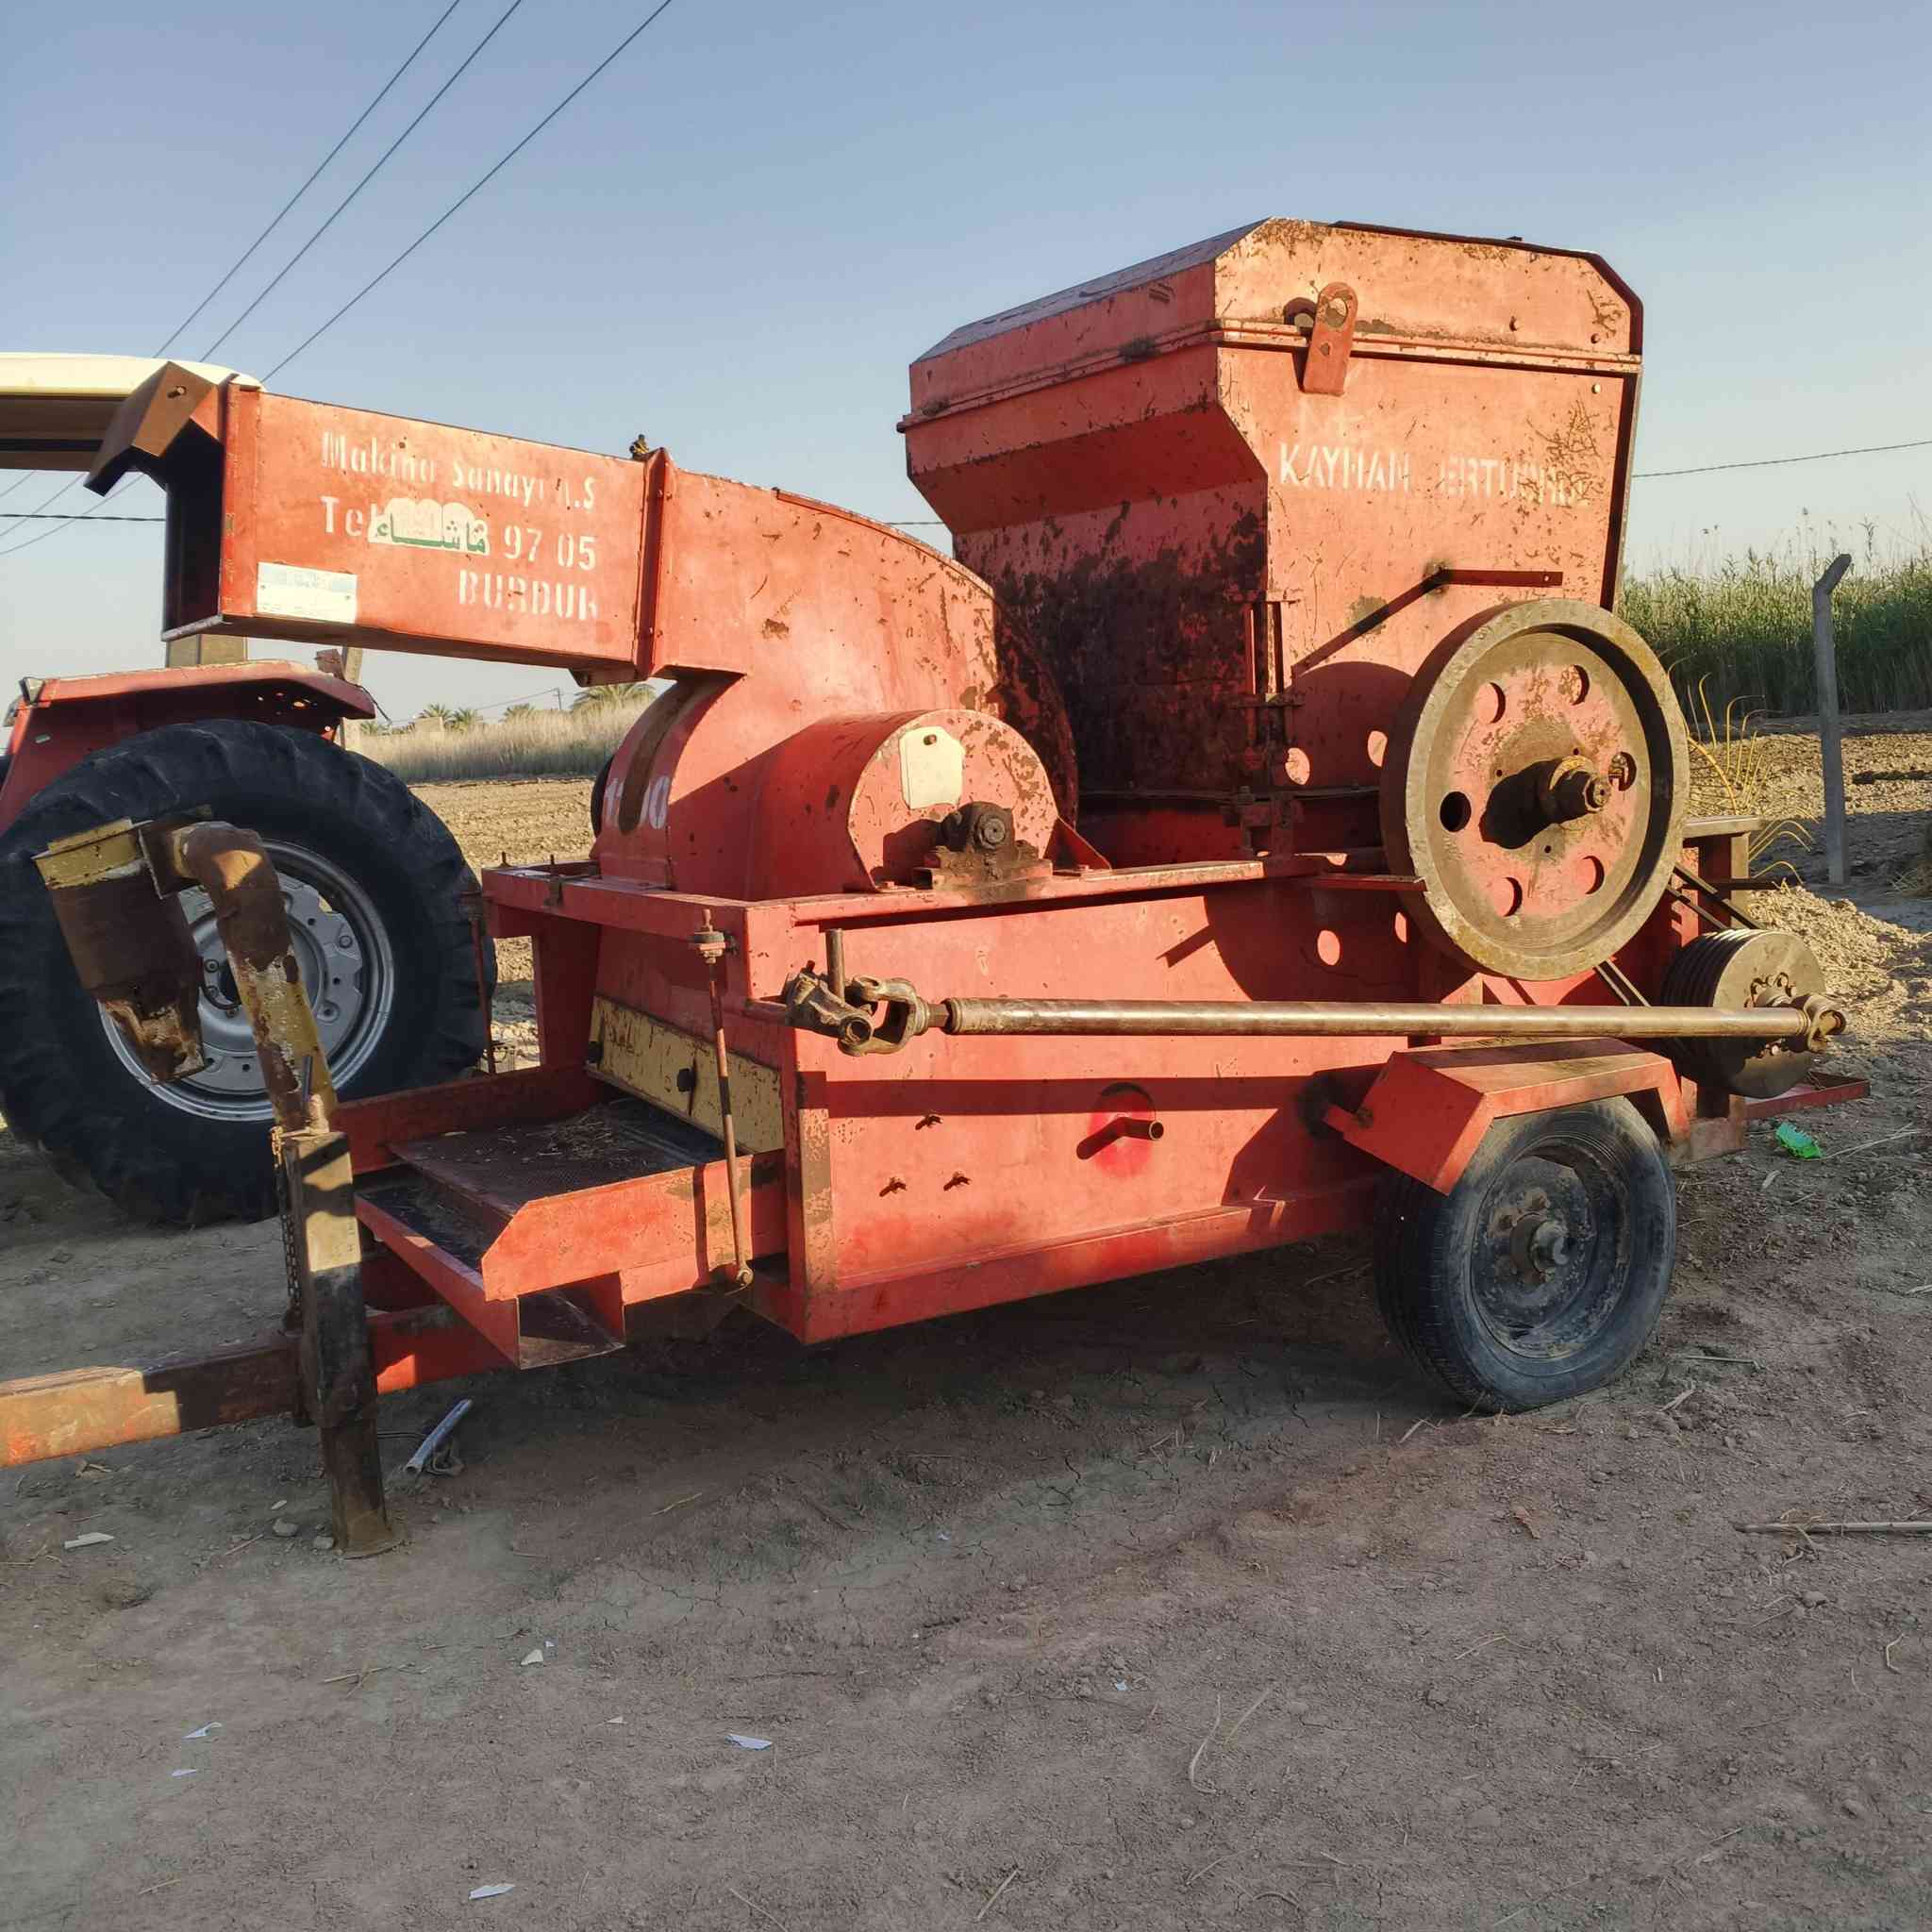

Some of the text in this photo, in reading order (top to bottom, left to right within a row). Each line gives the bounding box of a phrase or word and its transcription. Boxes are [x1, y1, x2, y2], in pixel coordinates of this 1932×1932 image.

[321, 430, 435, 483] Makina
[1280, 441, 1410, 496] KAYHAN
[505, 525, 542, 563] 97
[558, 532, 597, 572] 05
[458, 569, 599, 622] BURDUR
